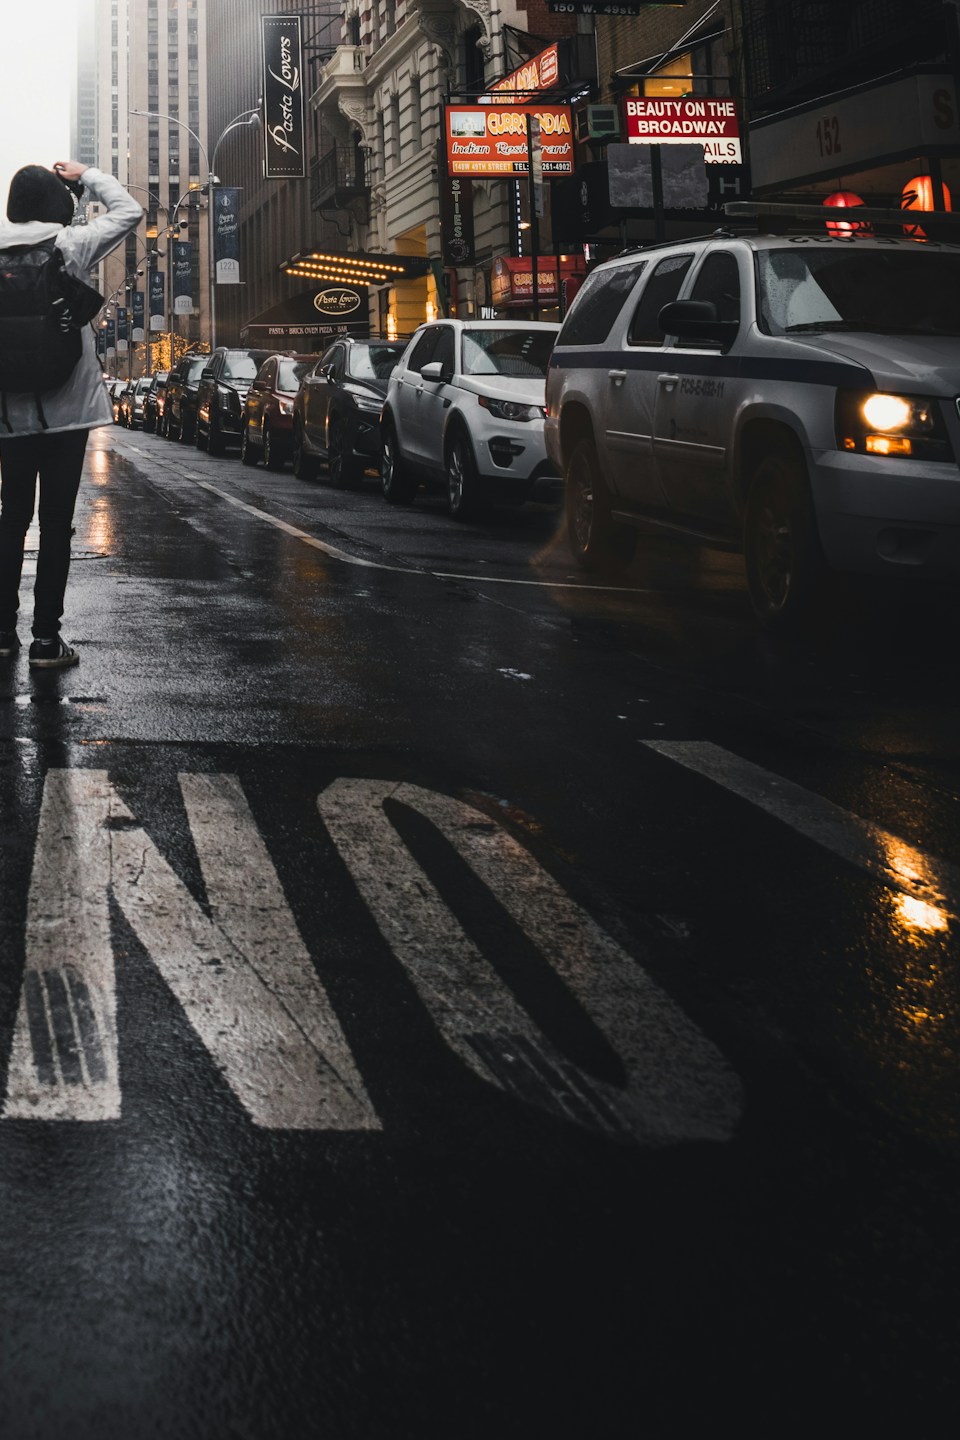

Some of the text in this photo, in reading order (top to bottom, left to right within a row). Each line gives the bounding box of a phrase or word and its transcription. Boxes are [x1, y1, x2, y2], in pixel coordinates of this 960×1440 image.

[553, 3, 575, 12] 150
[268, 35, 299, 92] Lovers
[626, 101, 736, 117] BEAUTY ON THE
[268, 94, 299, 155] Pasta
[638, 120, 727, 134] BROADWAY
[816, 117, 842, 158] 152
[451, 141, 490, 154] Indian
[703, 143, 736, 156] AILS
[487, 163, 511, 171] STREET
[220, 261, 236, 270] 1221
[317, 294, 337, 306] Pasta
[268, 327, 285, 335] PASTA
[304, 326, 319, 334] OVEN
[319, 326, 333, 334] PIZZA
[337, 325, 348, 333] BAR
